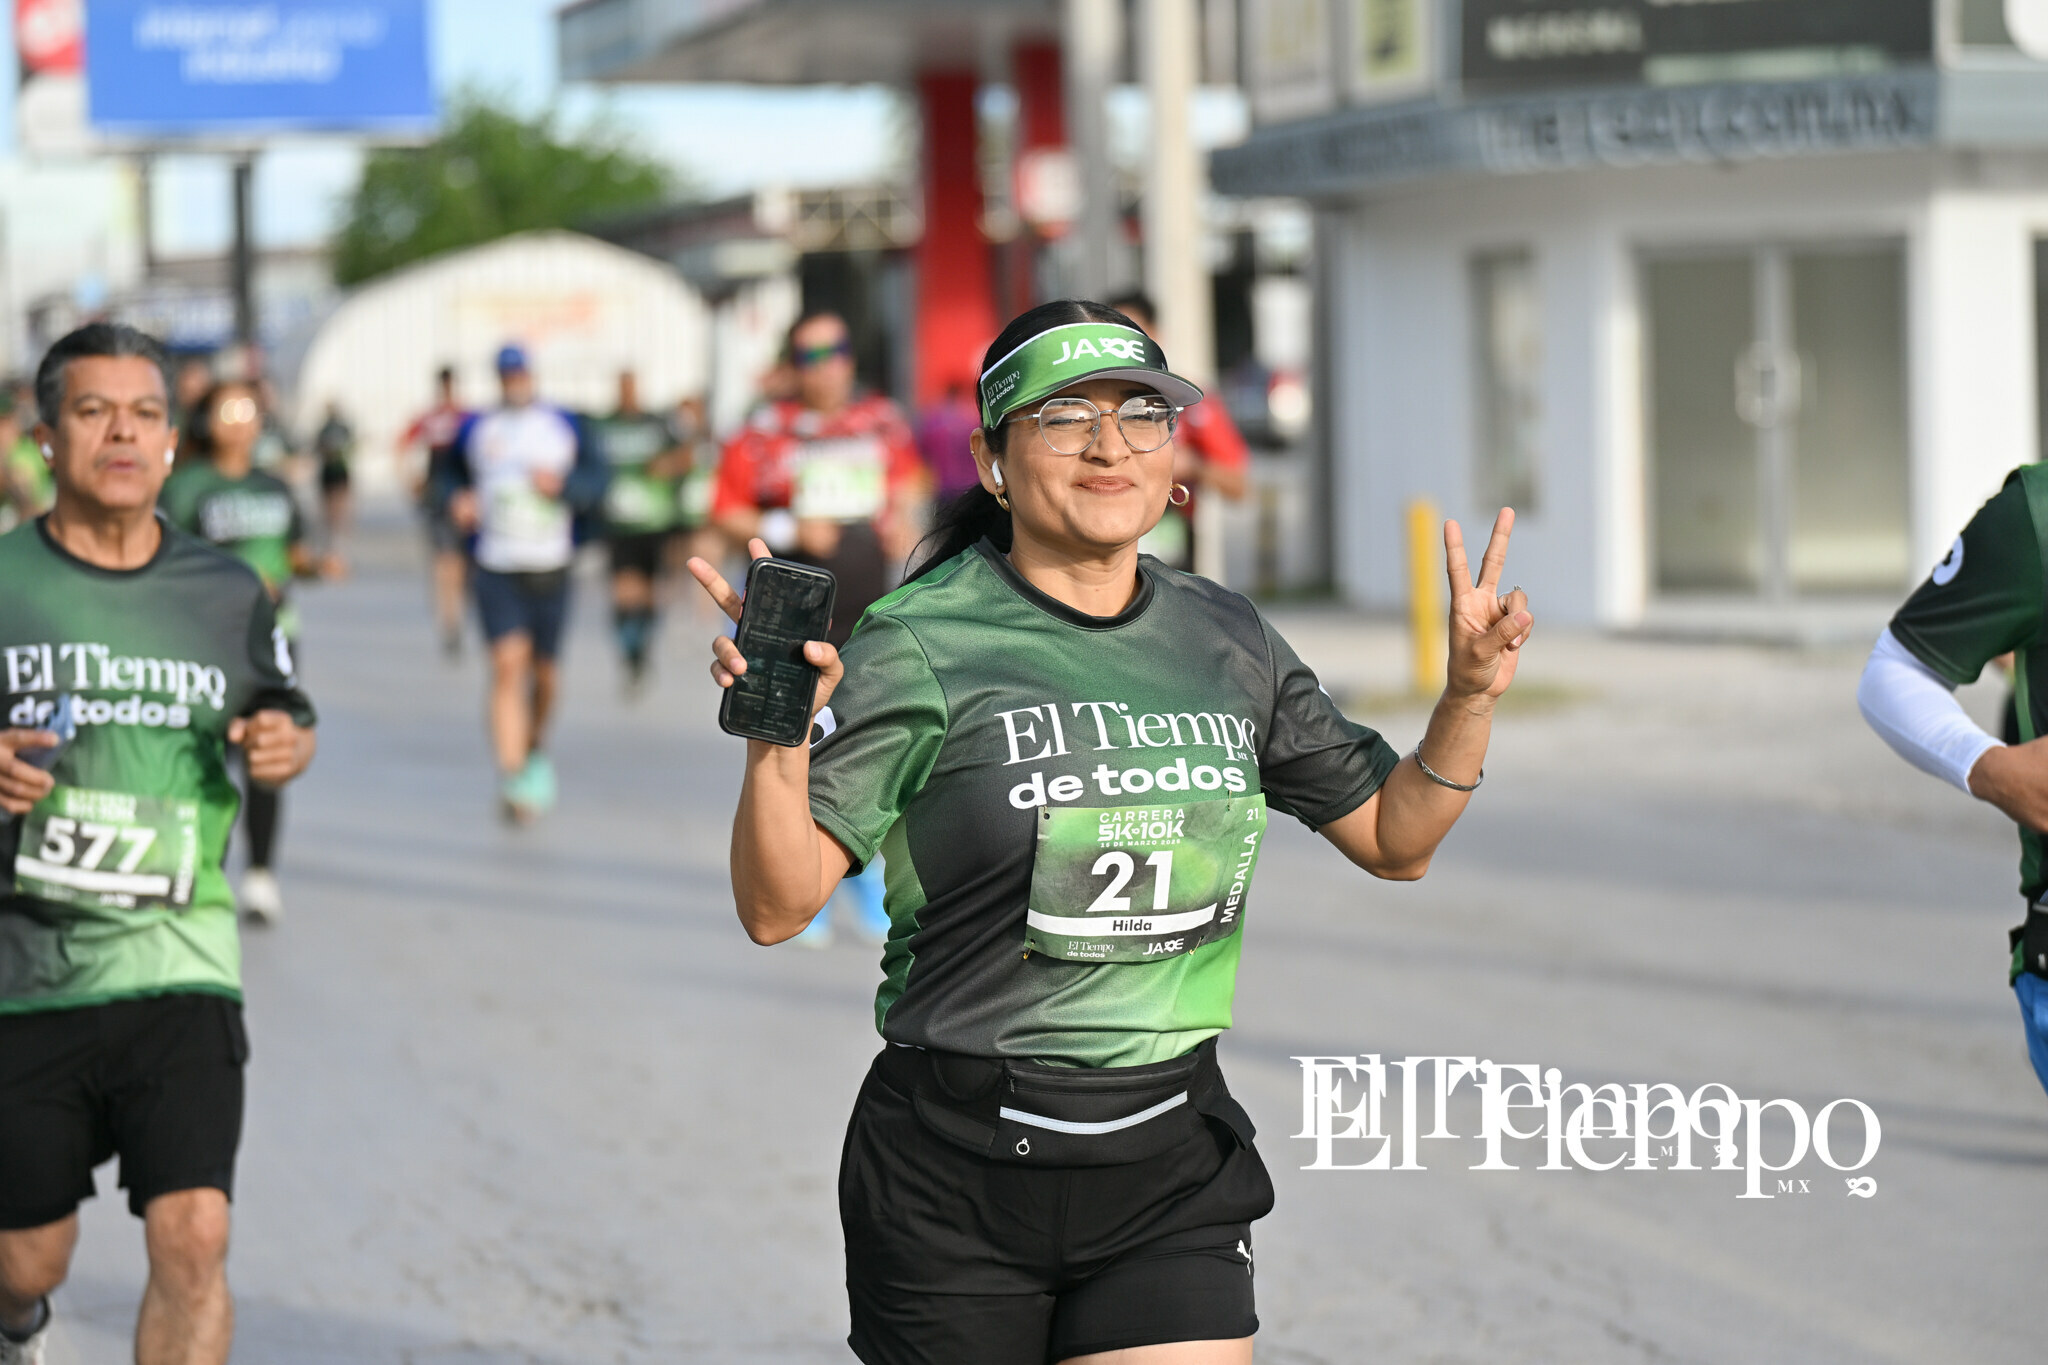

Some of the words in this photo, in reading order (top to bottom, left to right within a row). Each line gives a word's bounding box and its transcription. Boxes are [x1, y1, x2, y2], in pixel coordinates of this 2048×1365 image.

[989, 398, 997, 407] de
[996, 384, 1015, 400] todos
[4, 643, 55, 693] El
[59, 643, 227, 711] Tiempo
[70, 693, 191, 728] todos
[994, 703, 1071, 766] El
[1071, 701, 1258, 767] Tiempo
[1008, 771, 1084, 810] de
[1091, 757, 1247, 796] todos
[1099, 808, 1185, 824] CARRERA
[1246, 808, 1259, 821] 21
[39, 816, 157, 875] 577
[1127, 839, 1157, 847] MARZO
[1086, 851, 1173, 912] 21
[1220, 831, 1259, 923] MEDALLA
[1112, 919, 1153, 932] Hilda
[1067, 940, 1078, 950] El
[1080, 941, 1114, 953] Tiempo
